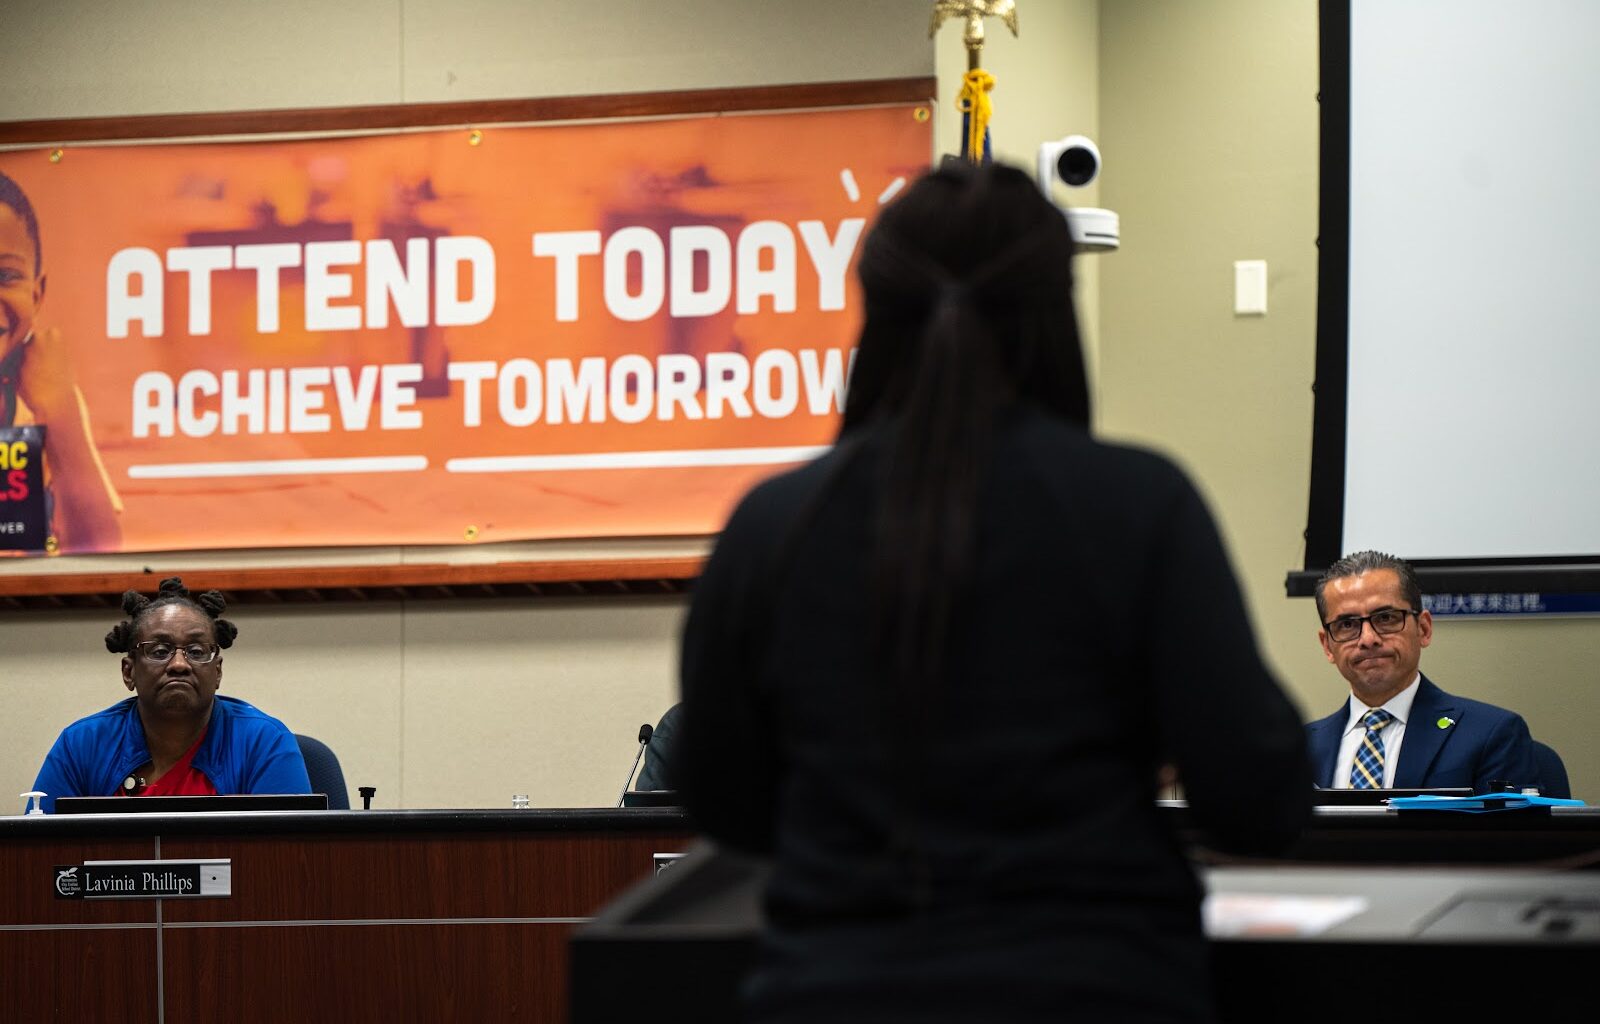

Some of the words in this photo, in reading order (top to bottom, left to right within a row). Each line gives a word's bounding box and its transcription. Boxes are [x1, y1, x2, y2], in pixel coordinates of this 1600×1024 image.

[106, 235, 496, 339] ATTEND
[532, 218, 866, 322] TODAY
[132, 363, 424, 438] ACHIEVE
[447, 348, 858, 427] TOMORROW
[85, 872, 136, 892] Lavinia
[142, 872, 193, 894] Phillips
